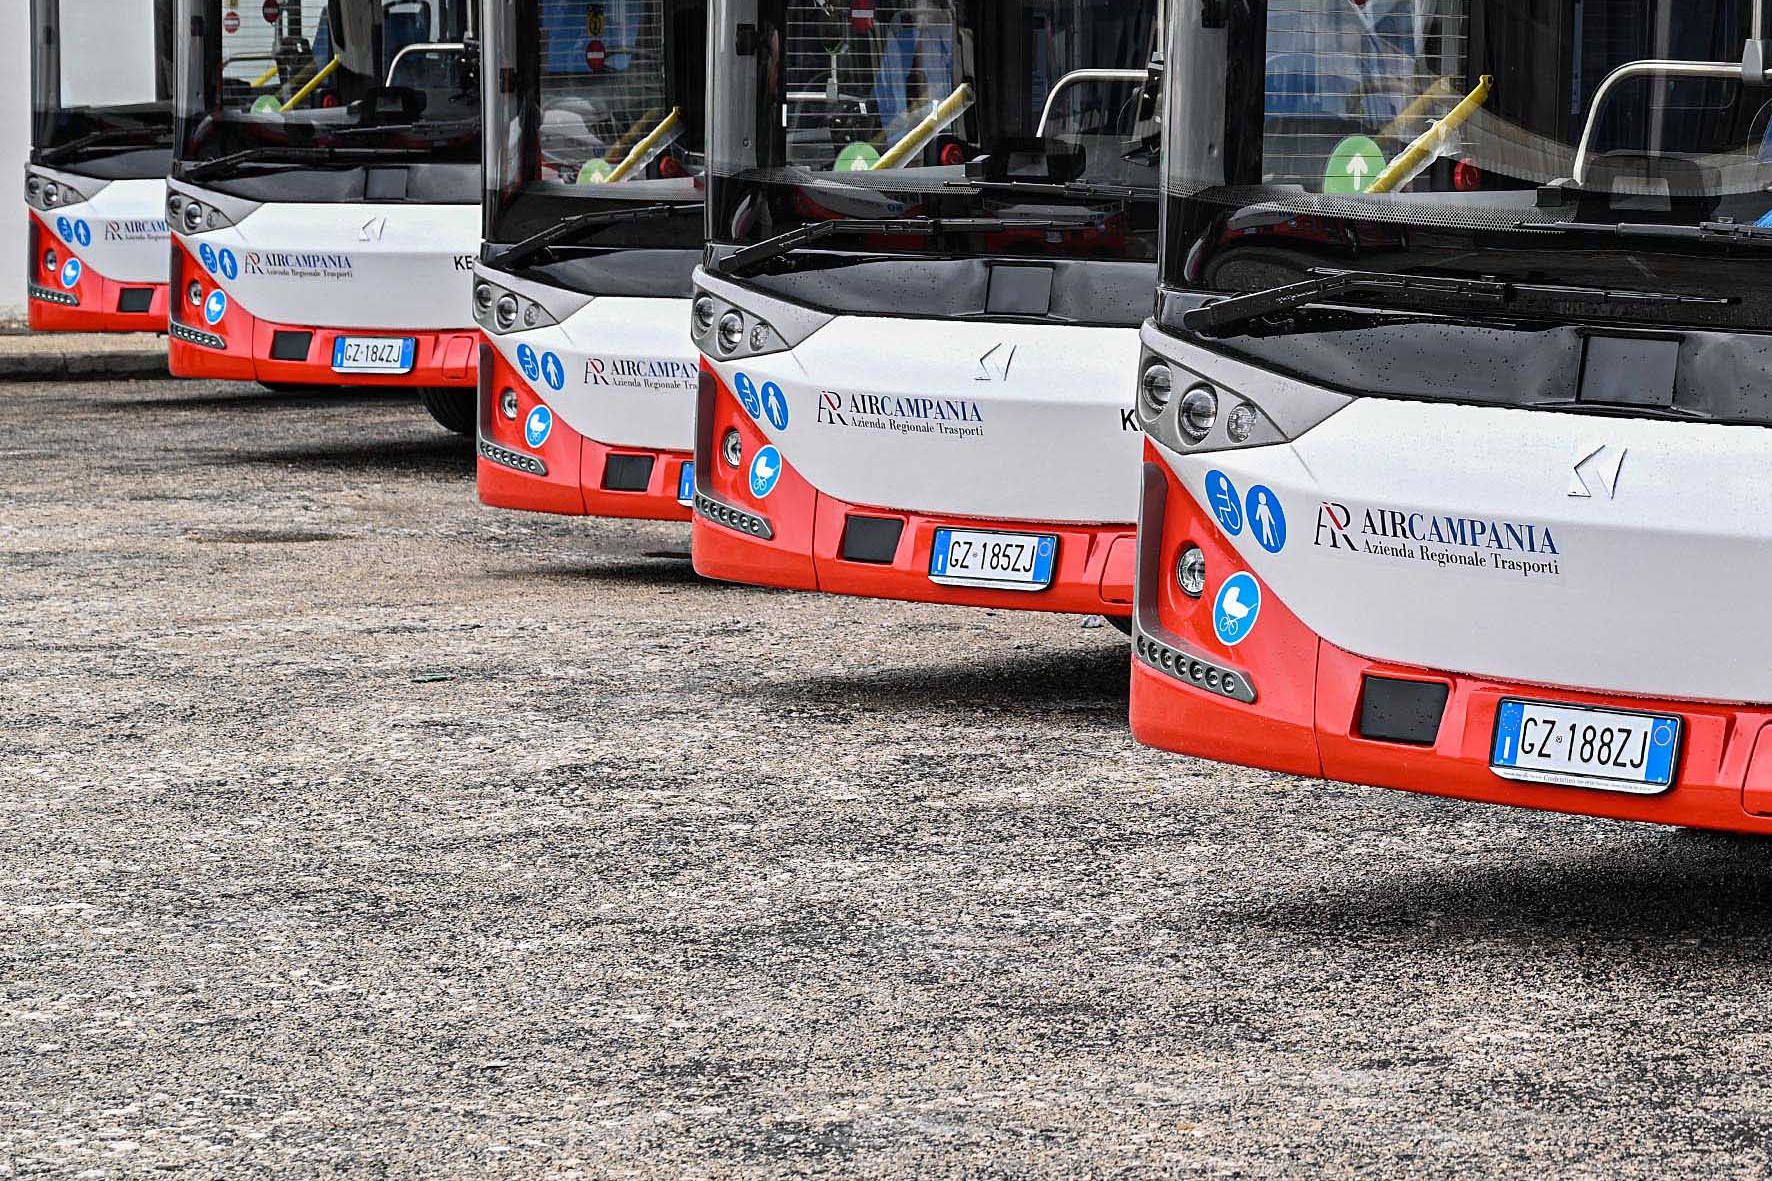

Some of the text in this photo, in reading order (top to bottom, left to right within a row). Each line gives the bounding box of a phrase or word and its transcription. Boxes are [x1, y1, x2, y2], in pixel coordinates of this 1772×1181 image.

[265, 254, 352, 268] AIRCAMPANIA
[453, 255, 479, 270] KE
[612, 378, 641, 388] Azienda
[644, 379, 680, 391] Regionale
[849, 394, 984, 423] AIRCAMPANIA
[851, 416, 984, 439] Azienda Regionale Trasporti
[1361, 507, 1560, 555] AIRCAMPANIA
[1363, 538, 1560, 576] Azienda Regionale Trasporti
